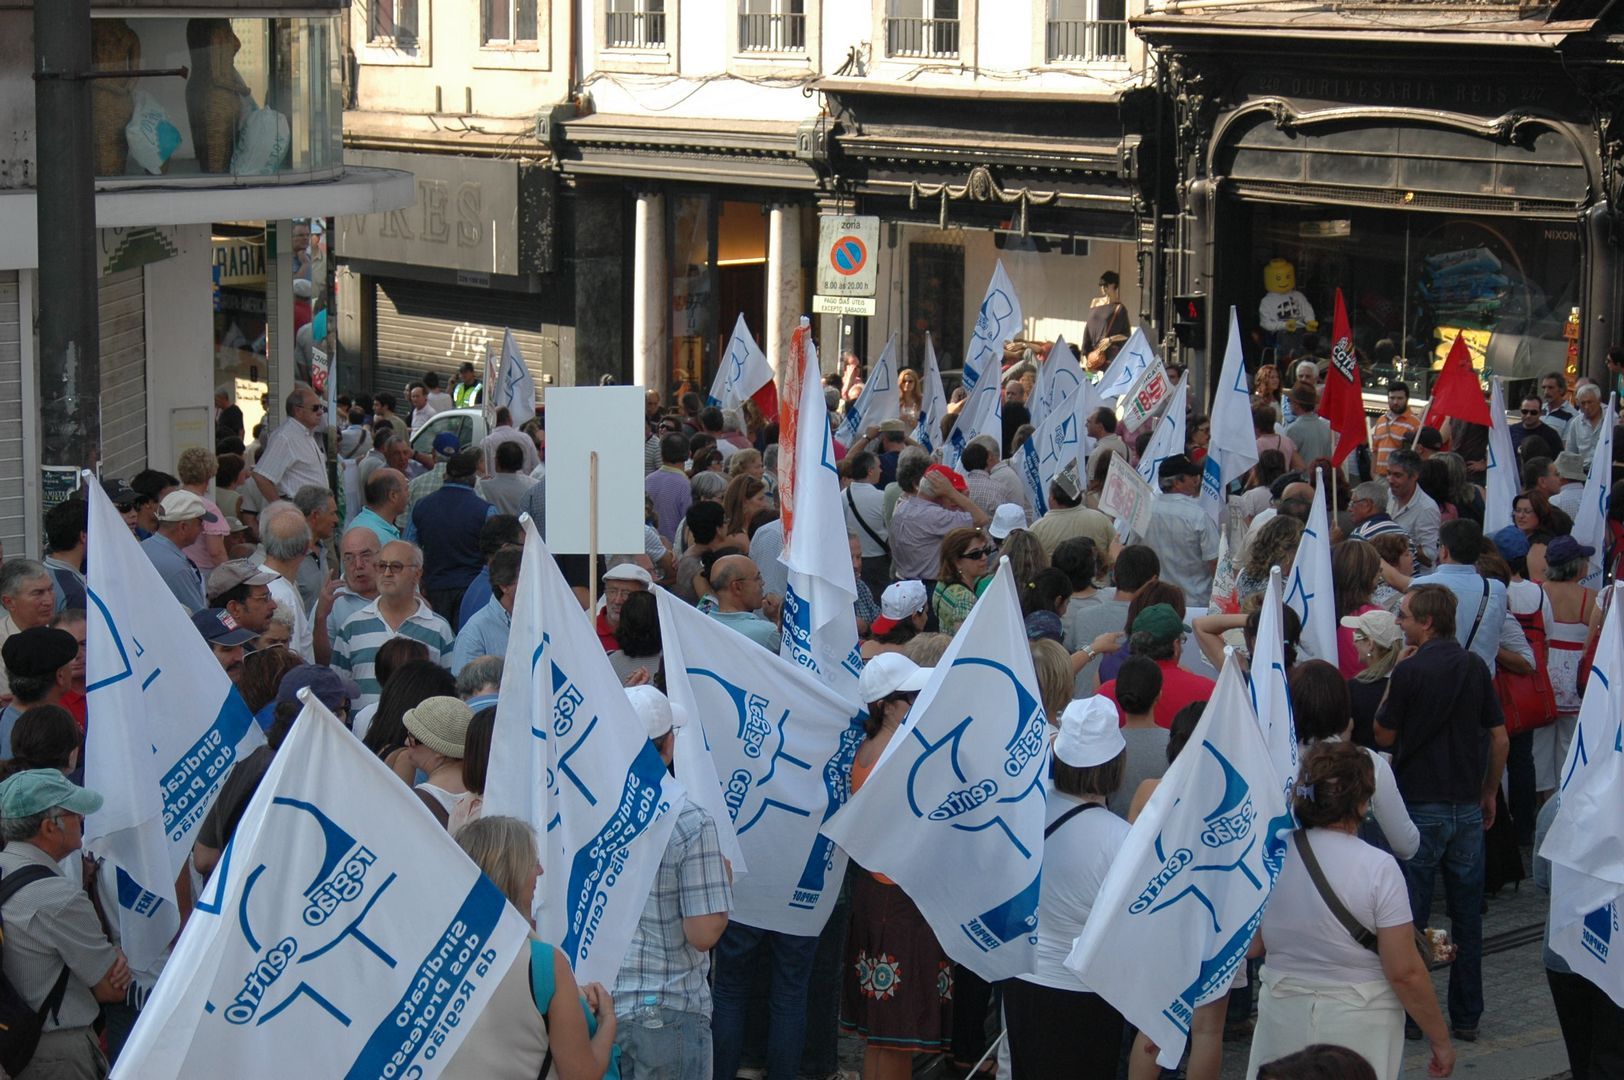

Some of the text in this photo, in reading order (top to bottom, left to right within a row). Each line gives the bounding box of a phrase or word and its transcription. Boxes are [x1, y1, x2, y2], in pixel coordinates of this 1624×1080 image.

[1292, 78, 1436, 102] OURIVESARIA
[1456, 84, 1507, 103] REIS
[841, 221, 861, 230] zona
[1544, 229, 1577, 241] NIXON
[212, 245, 266, 277] RARIA
[824, 281, 838, 290] 8.00
[847, 281, 863, 290] 20.00
